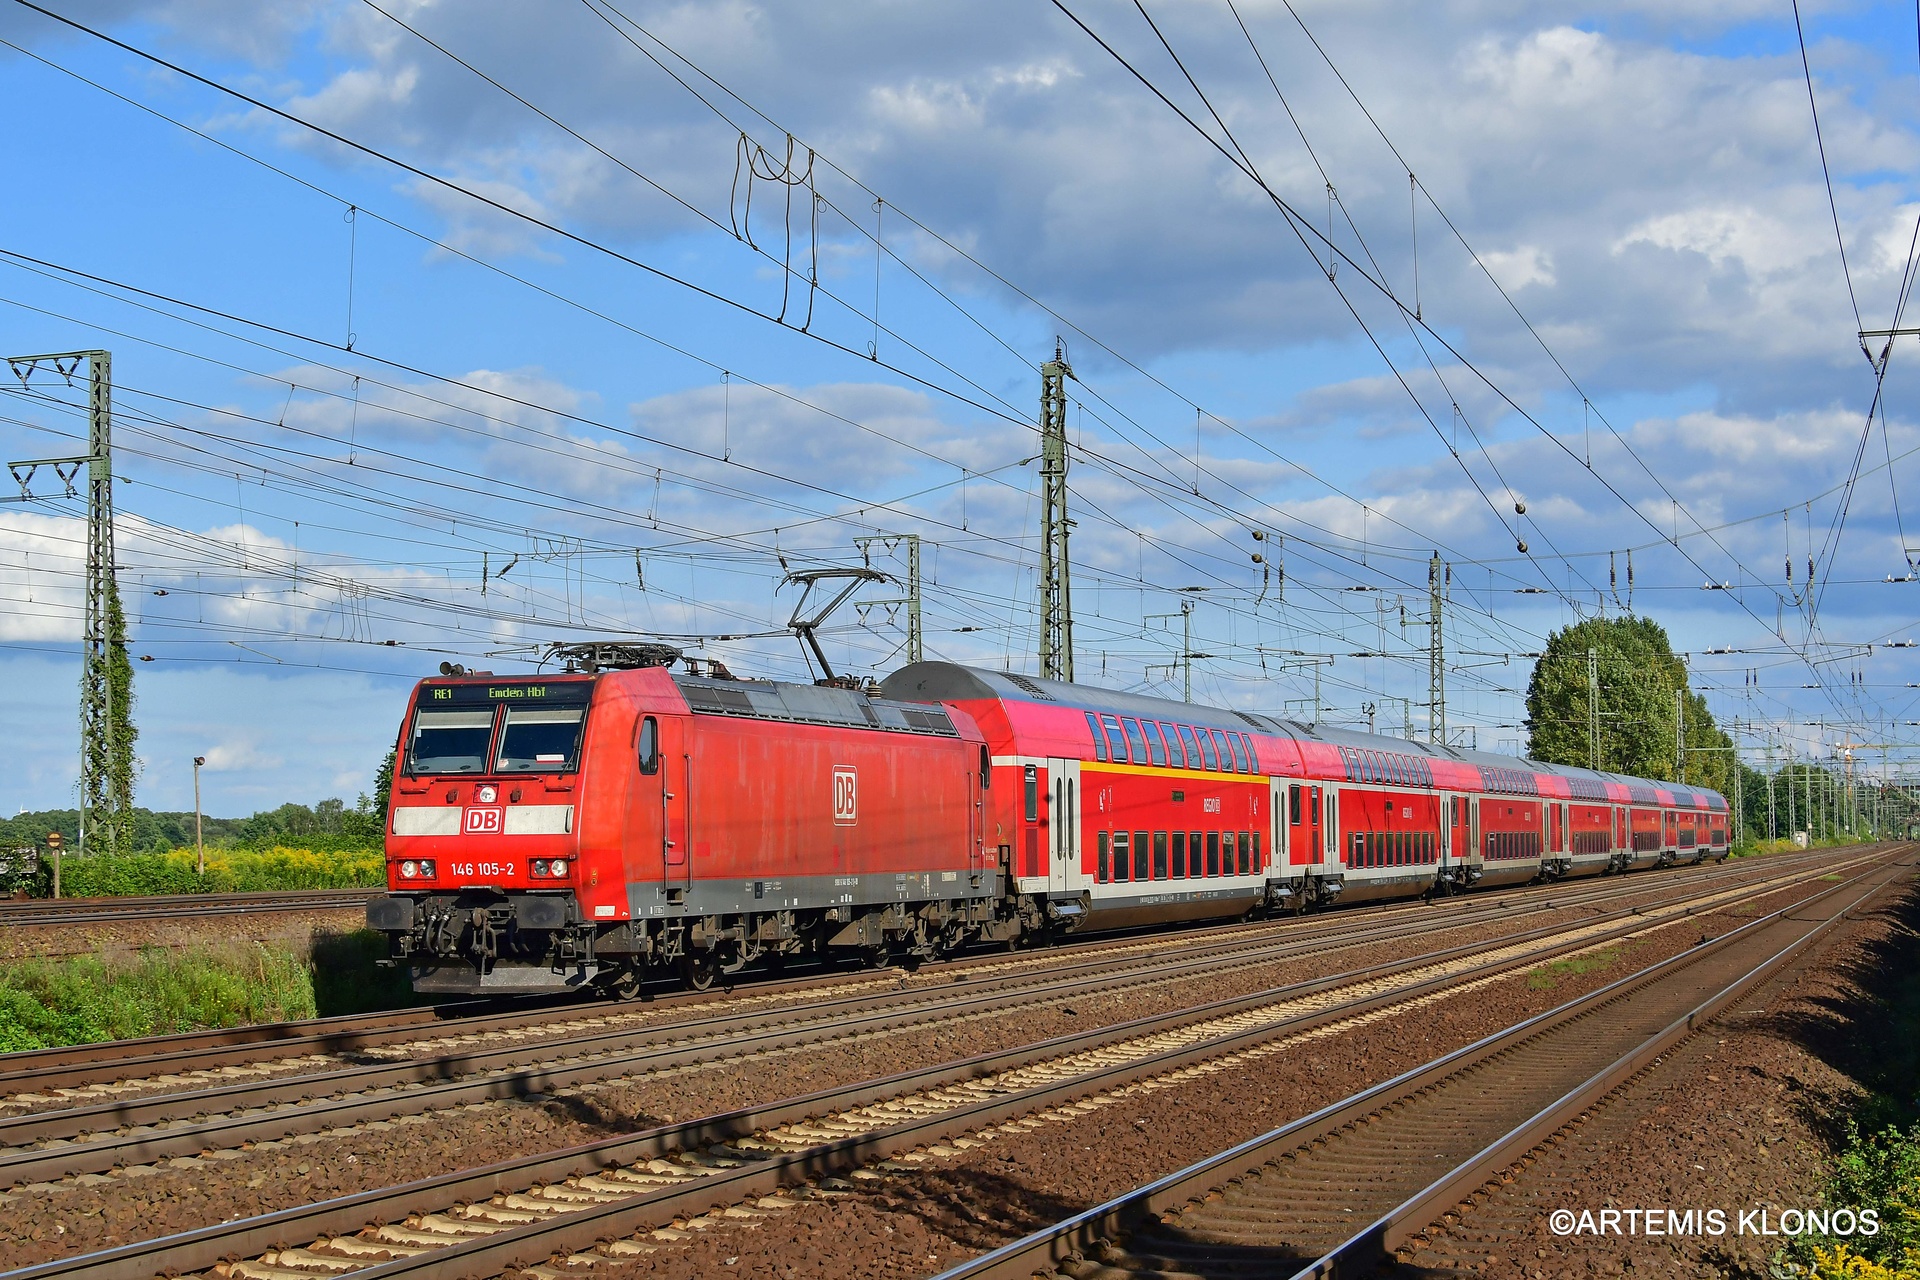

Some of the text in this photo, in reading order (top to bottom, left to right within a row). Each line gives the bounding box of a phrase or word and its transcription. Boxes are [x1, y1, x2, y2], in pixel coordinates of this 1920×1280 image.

[434, 689, 452, 699] RE1
[489, 687, 546, 698] Emden Hbf
[837, 776, 854, 814] DB
[469, 811, 497, 829] DB
[451, 863, 515, 876] 146 105-2
